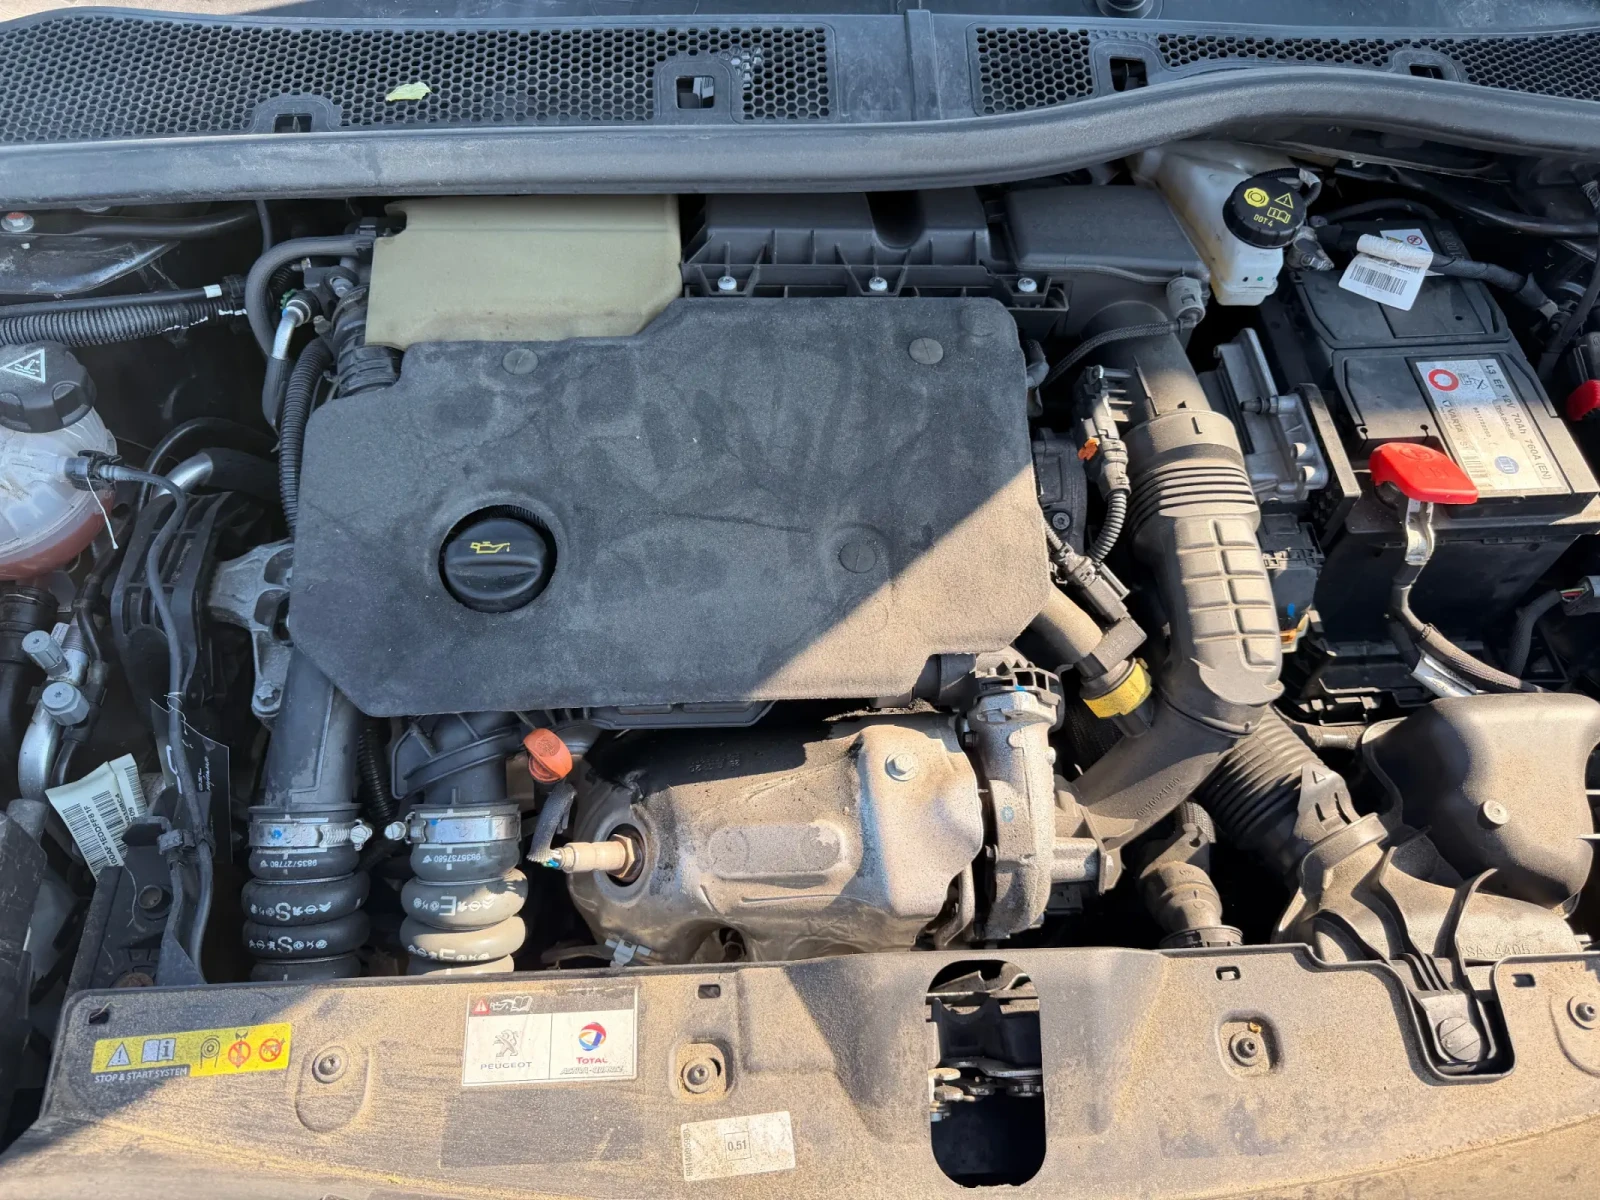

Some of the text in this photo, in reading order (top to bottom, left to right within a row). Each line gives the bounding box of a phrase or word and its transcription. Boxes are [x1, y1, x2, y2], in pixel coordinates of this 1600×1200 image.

[1253, 213, 1268, 224] DOT
[1446, 407, 1464, 434] VARTA
[1485, 364, 1498, 376] L3
[1493, 378, 1506, 390] EF
[1501, 394, 1516, 409] 12V
[1510, 412, 1528, 435] 70Ah
[1524, 437, 1543, 461] 760A
[1535, 461, 1553, 481] (EN)
[480, 1061, 533, 1070] PEUGEOT
[94, 1067, 188, 1083] STOP & START SYSTEM
